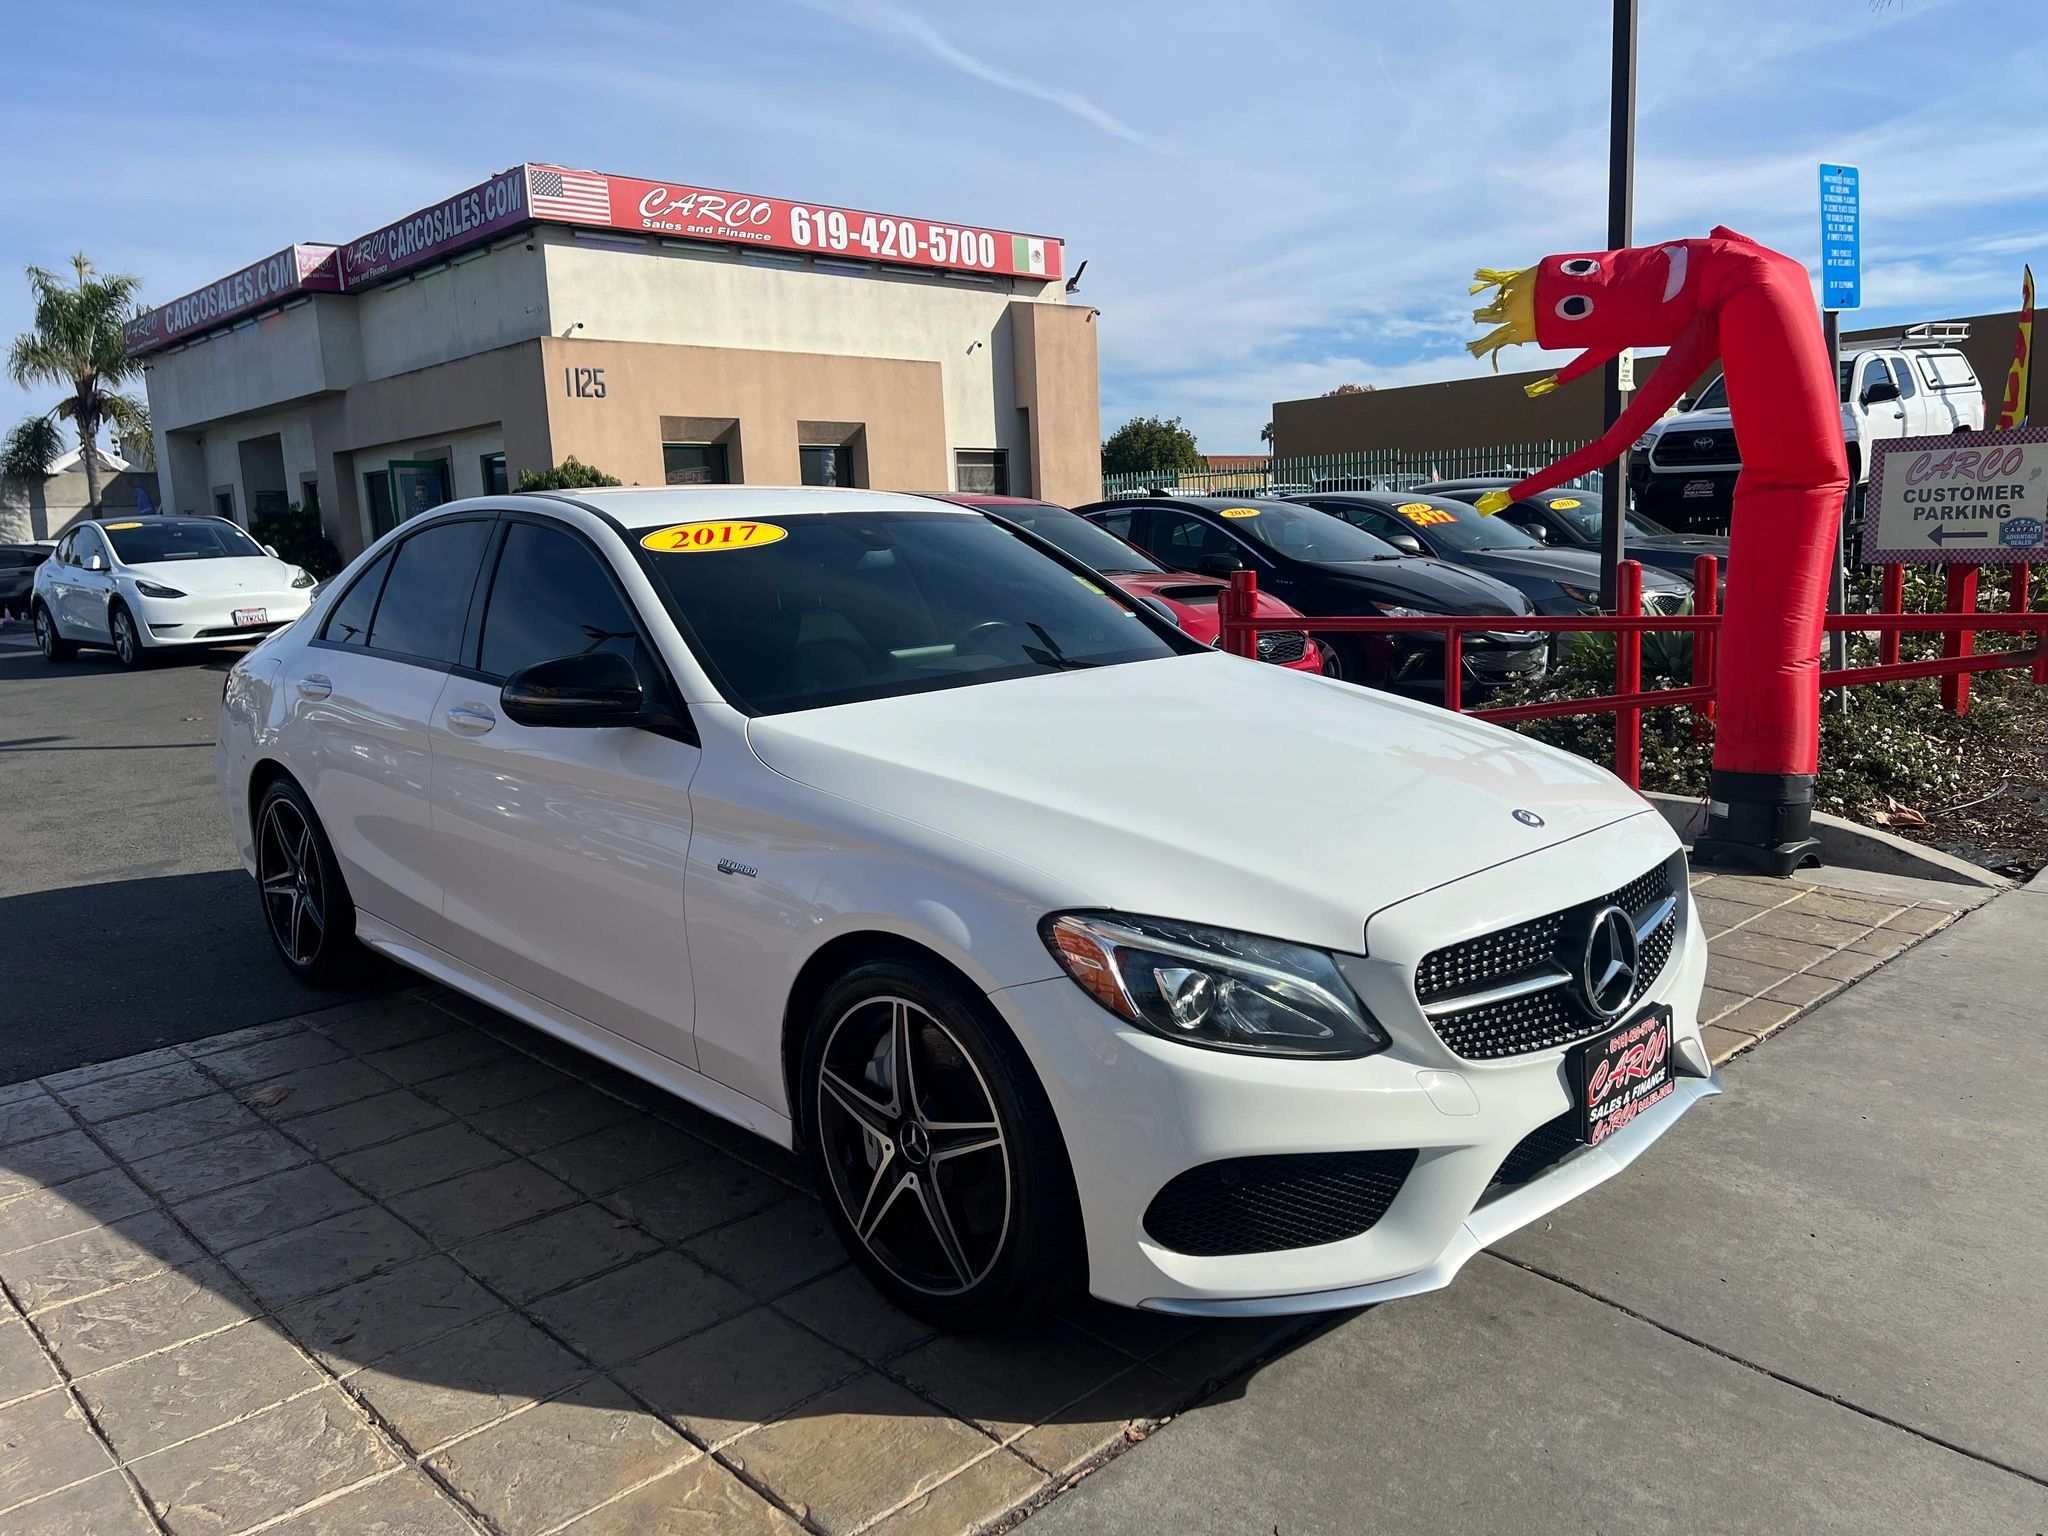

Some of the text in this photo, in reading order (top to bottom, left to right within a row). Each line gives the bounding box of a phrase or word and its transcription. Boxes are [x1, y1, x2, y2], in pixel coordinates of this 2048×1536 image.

[388, 173, 521, 261] CARCOSALES.COM
[639, 187, 772, 227] CARCO
[642, 218, 772, 241] Sales and Finance
[790, 206, 996, 268] 619-420-5700
[346, 232, 386, 272] CARCO
[165, 251, 293, 334] CARCOSALES.COM
[125, 312, 157, 344] CARCO
[565, 367, 606, 398] 1125
[1905, 447, 2024, 485] CARCO
[1903, 484, 2025, 503] CUSTOMER
[1913, 503, 2011, 521] PARKING
[671, 525, 758, 549] 2017
[1588, 1026, 1666, 1107] CARCO
[1590, 1067, 1666, 1122] SALES & FINANCE
